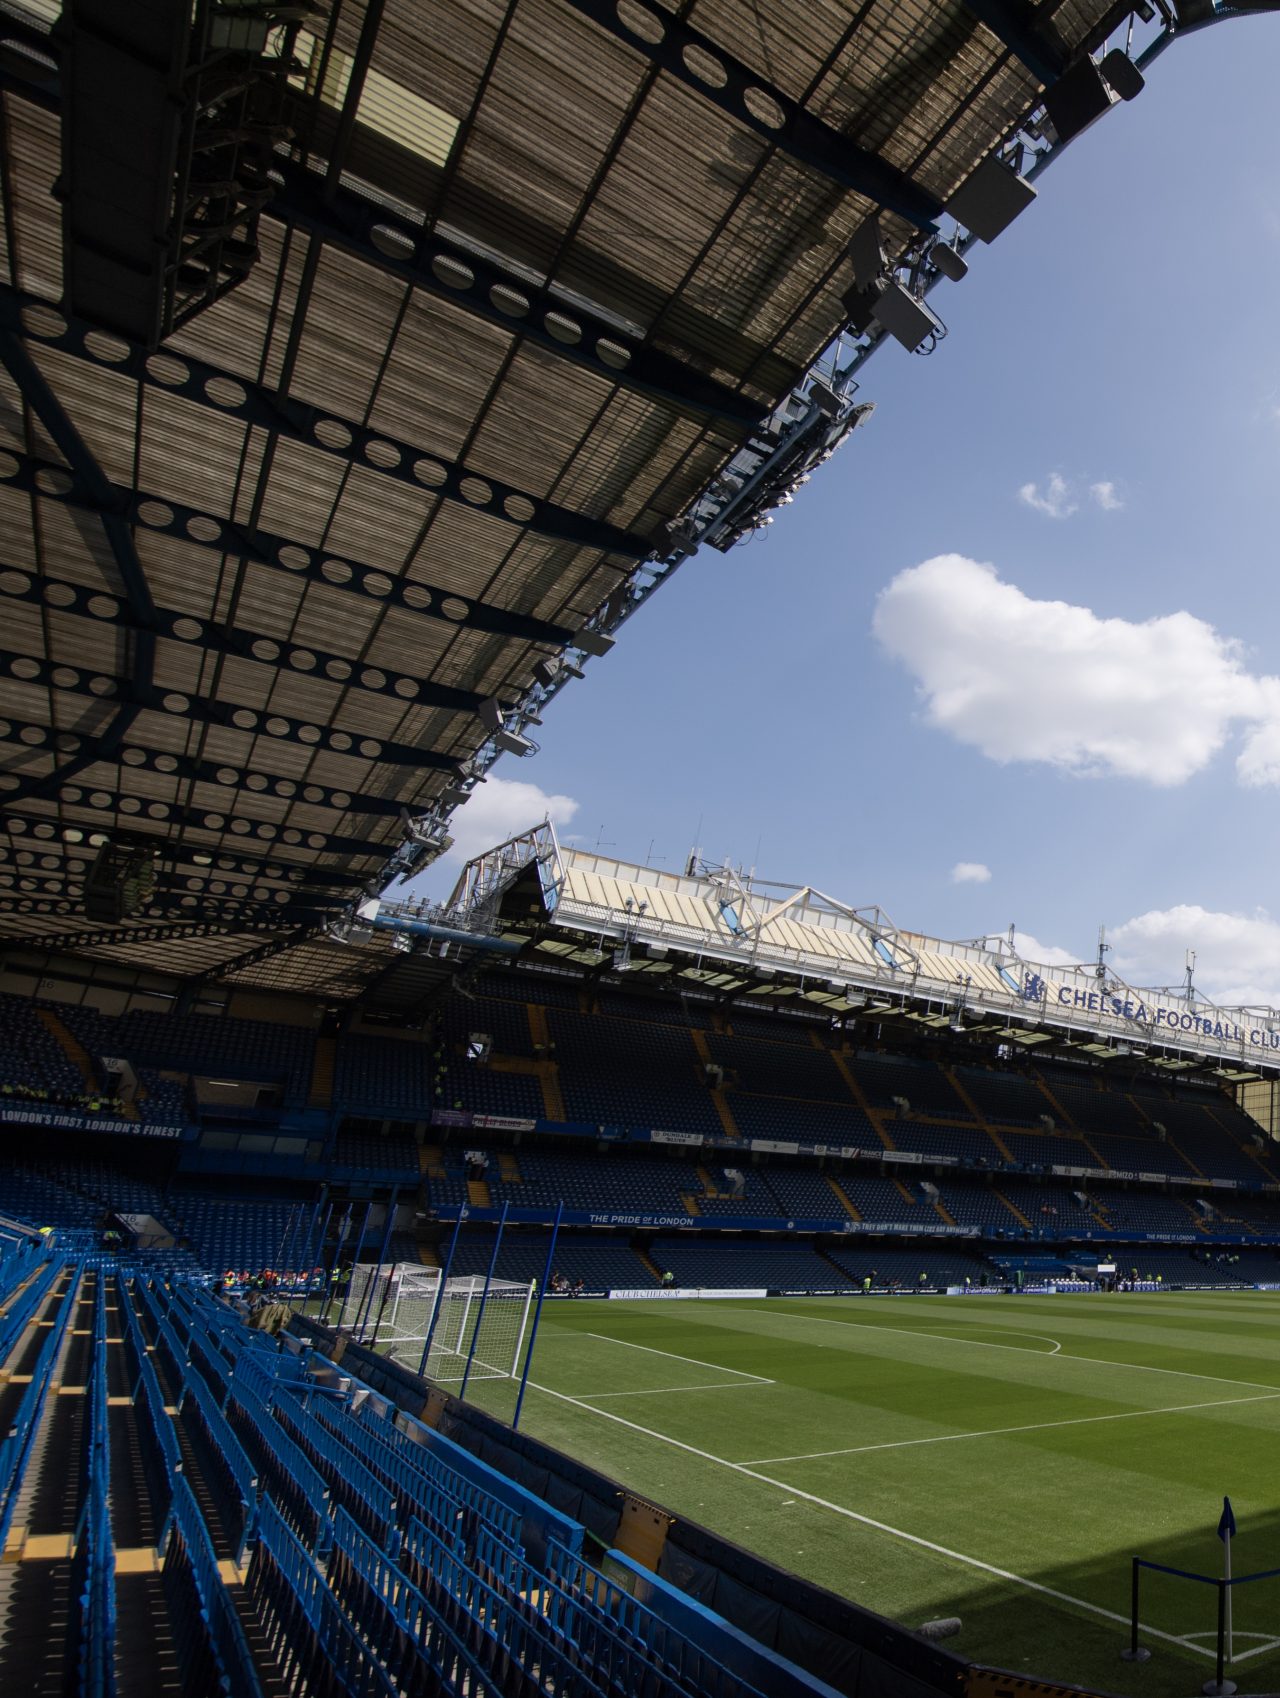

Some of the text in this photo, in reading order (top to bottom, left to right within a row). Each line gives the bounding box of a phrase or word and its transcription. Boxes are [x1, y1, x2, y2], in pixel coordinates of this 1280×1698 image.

[42, 980, 54, 989] 16
[1058, 986, 1147, 1021] CHELSEA
[1154, 1008, 1241, 1040] FOOTBALL
[2, 1110, 183, 1138] LONDON'S FIRST, LONDON'S FINEST
[125, 1215, 136, 1223] 16
[590, 1214, 694, 1226] THE PRIDE OF LONDON
[616, 1290, 639, 1298] CLUB
[640, 1290, 679, 1298] CHELSEA
